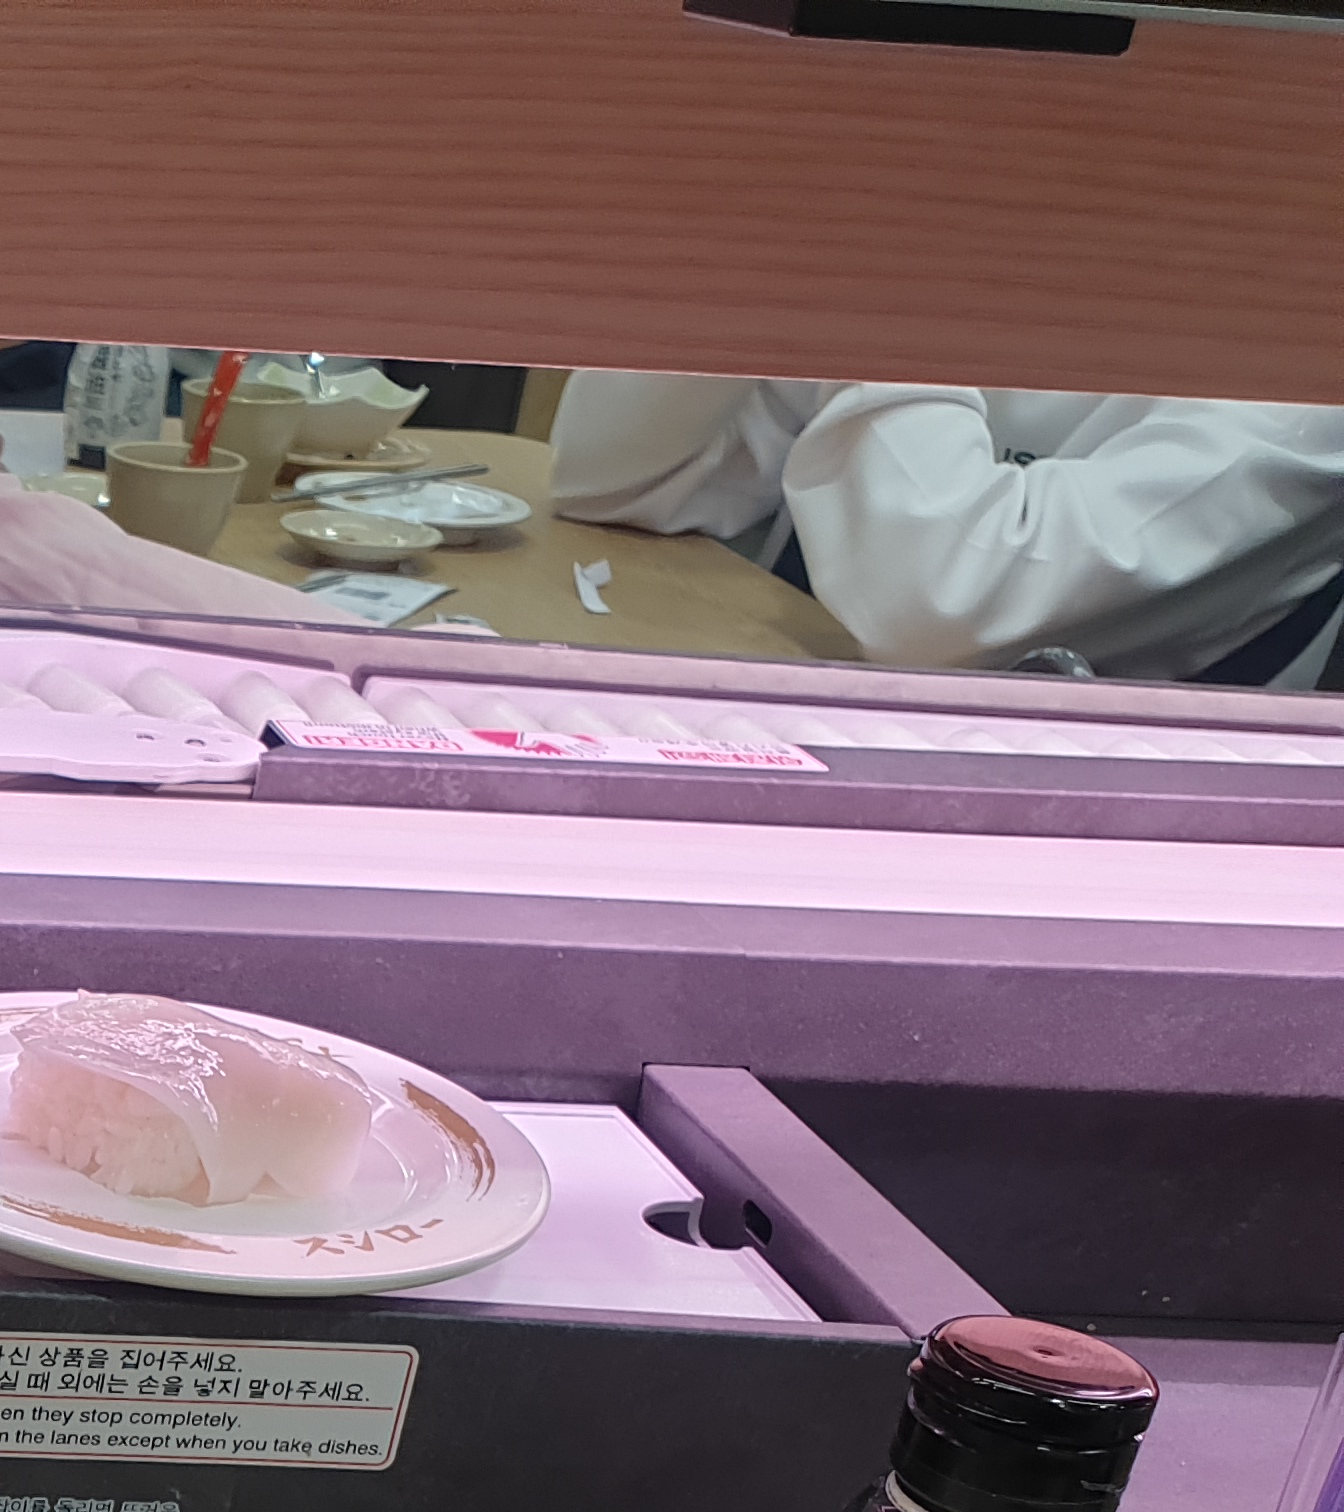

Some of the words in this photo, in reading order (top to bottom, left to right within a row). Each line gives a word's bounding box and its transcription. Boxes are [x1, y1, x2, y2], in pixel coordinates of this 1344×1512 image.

[293, 1216, 446, 1258] スシロー
[38, 1346, 110, 1370] 상품을
[119, 1348, 243, 1374] 집어주세요.
[27, 1370, 51, 1393] 때
[57, 1372, 129, 1396] 외에는
[137, 1374, 184, 1397] 손을
[193, 1376, 240, 1399] 넣지
[247, 1377, 370, 1403] 말아주세요.
[31, 1406, 75, 1426] they
[79, 1408, 123, 1428] stop
[128, 1409, 242, 1430] completely.
[14, 1427, 46, 1445] the
[49, 1429, 102, 1447] lanes
[106, 1433, 170, 1451] except
[174, 1434, 228, 1451] when
[232, 1440, 267, 1456] you
[273, 1437, 312, 1455] take
[317, 1439, 384, 1457] dishes.
